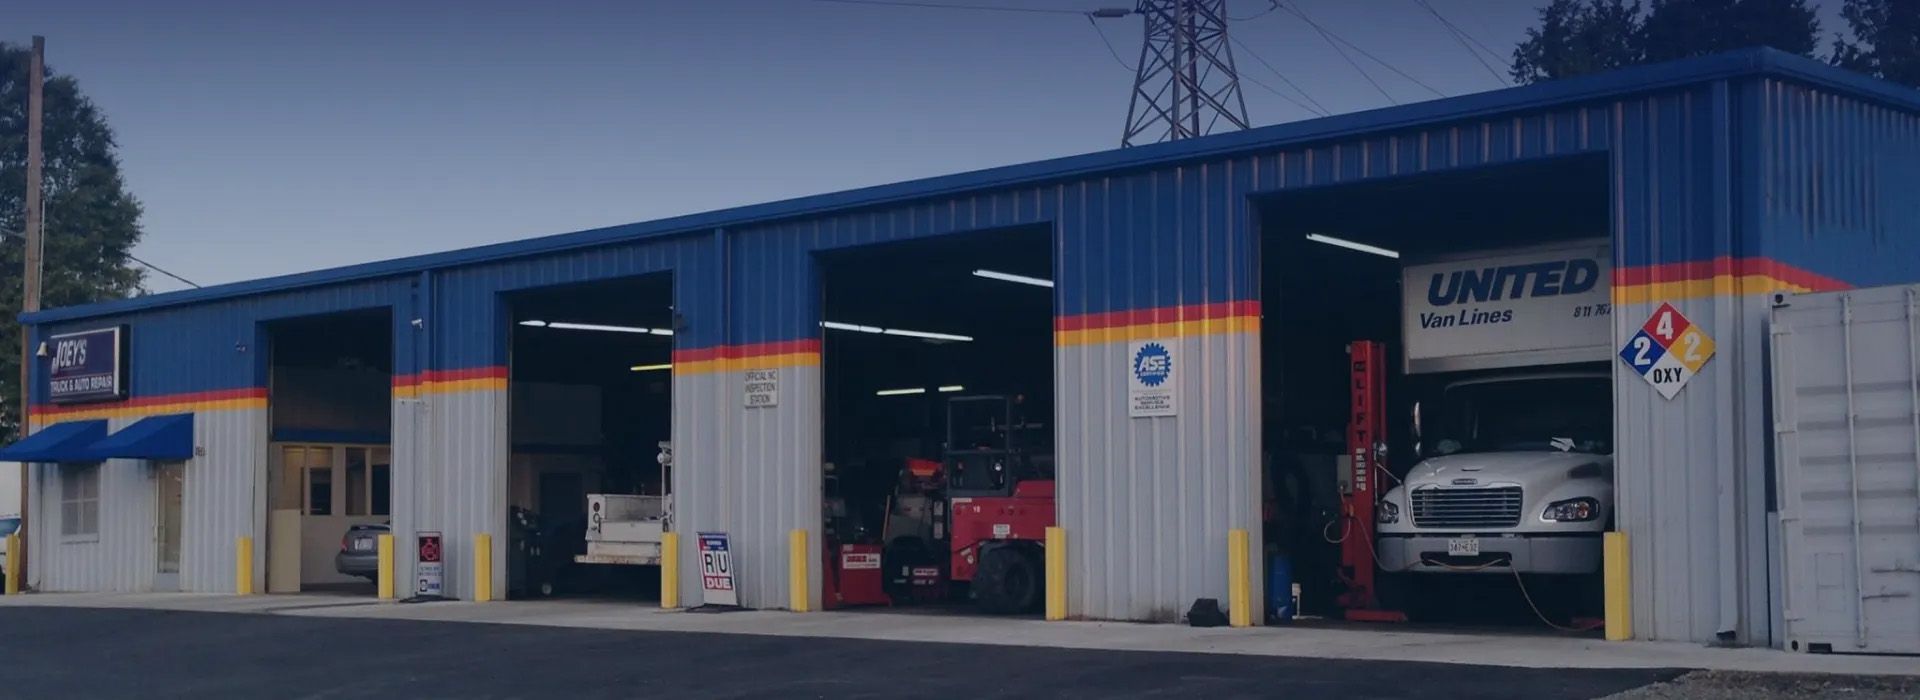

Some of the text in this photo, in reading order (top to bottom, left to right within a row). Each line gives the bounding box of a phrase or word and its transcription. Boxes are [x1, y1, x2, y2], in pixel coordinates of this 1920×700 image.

[1428, 258, 1600, 306] UNITED
[1420, 308, 1513, 329] Van Lines
[1656, 311, 1674, 340] 4
[51, 339, 88, 375] JOEY'S
[1633, 331, 1702, 366] 2 2
[1138, 354, 1166, 373] ASE
[50, 379, 69, 394] TRUCK
[74, 378, 90, 391] AUTO
[91, 375, 113, 390] REPAIR
[745, 372, 768, 381] OFFICIAL
[1653, 367, 1682, 384] OXY
[745, 383, 775, 393] INSPECTION
[750, 394, 770, 405] STATION
[706, 577, 732, 589] DUE
